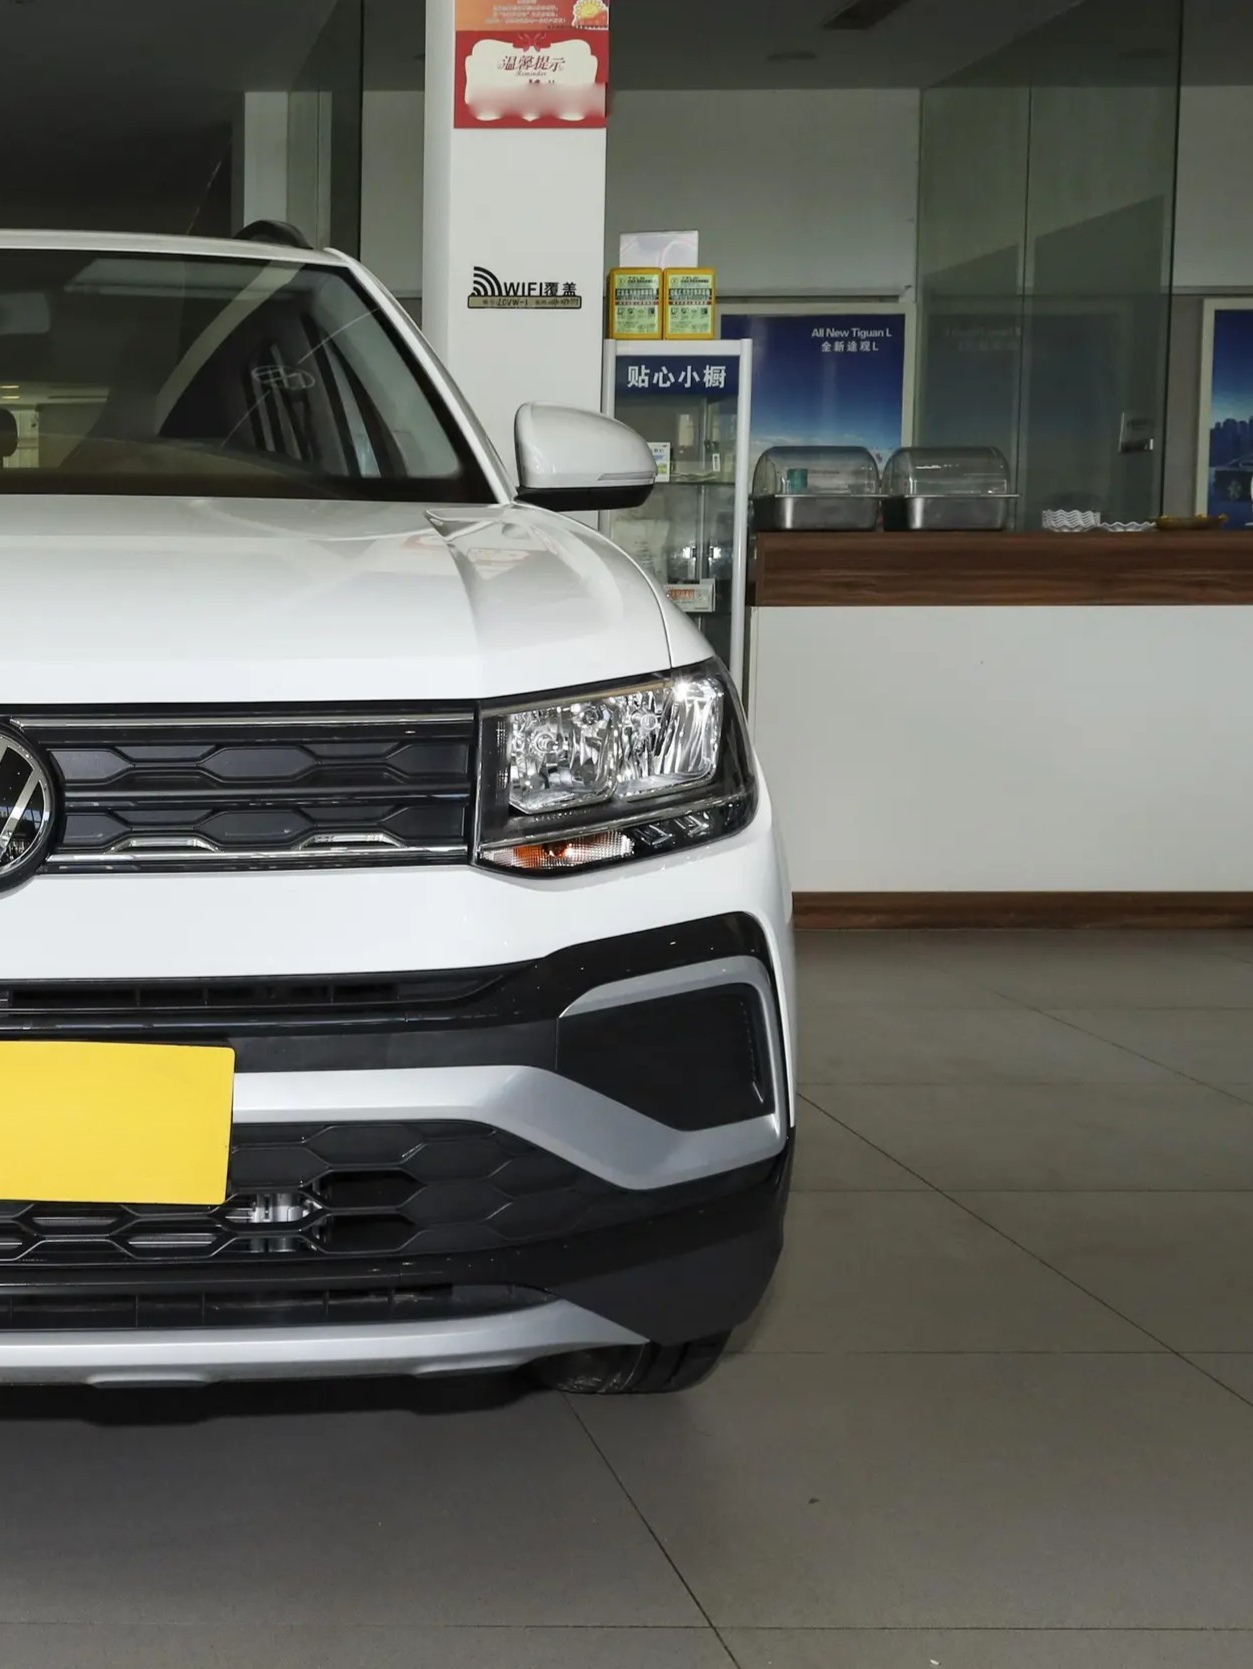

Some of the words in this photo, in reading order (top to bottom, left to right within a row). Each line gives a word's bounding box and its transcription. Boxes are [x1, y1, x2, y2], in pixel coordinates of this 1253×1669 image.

[502, 55, 566, 72] 温馨提示
[503, 282, 577, 297] WIFI覆盖
[811, 328, 825, 338] All
[826, 328, 849, 338] New
[851, 327, 884, 340] Tiguan
[885, 328, 893, 338] L
[821, 341, 879, 353] 全新途观L
[627, 364, 727, 389] 贴心小橱
